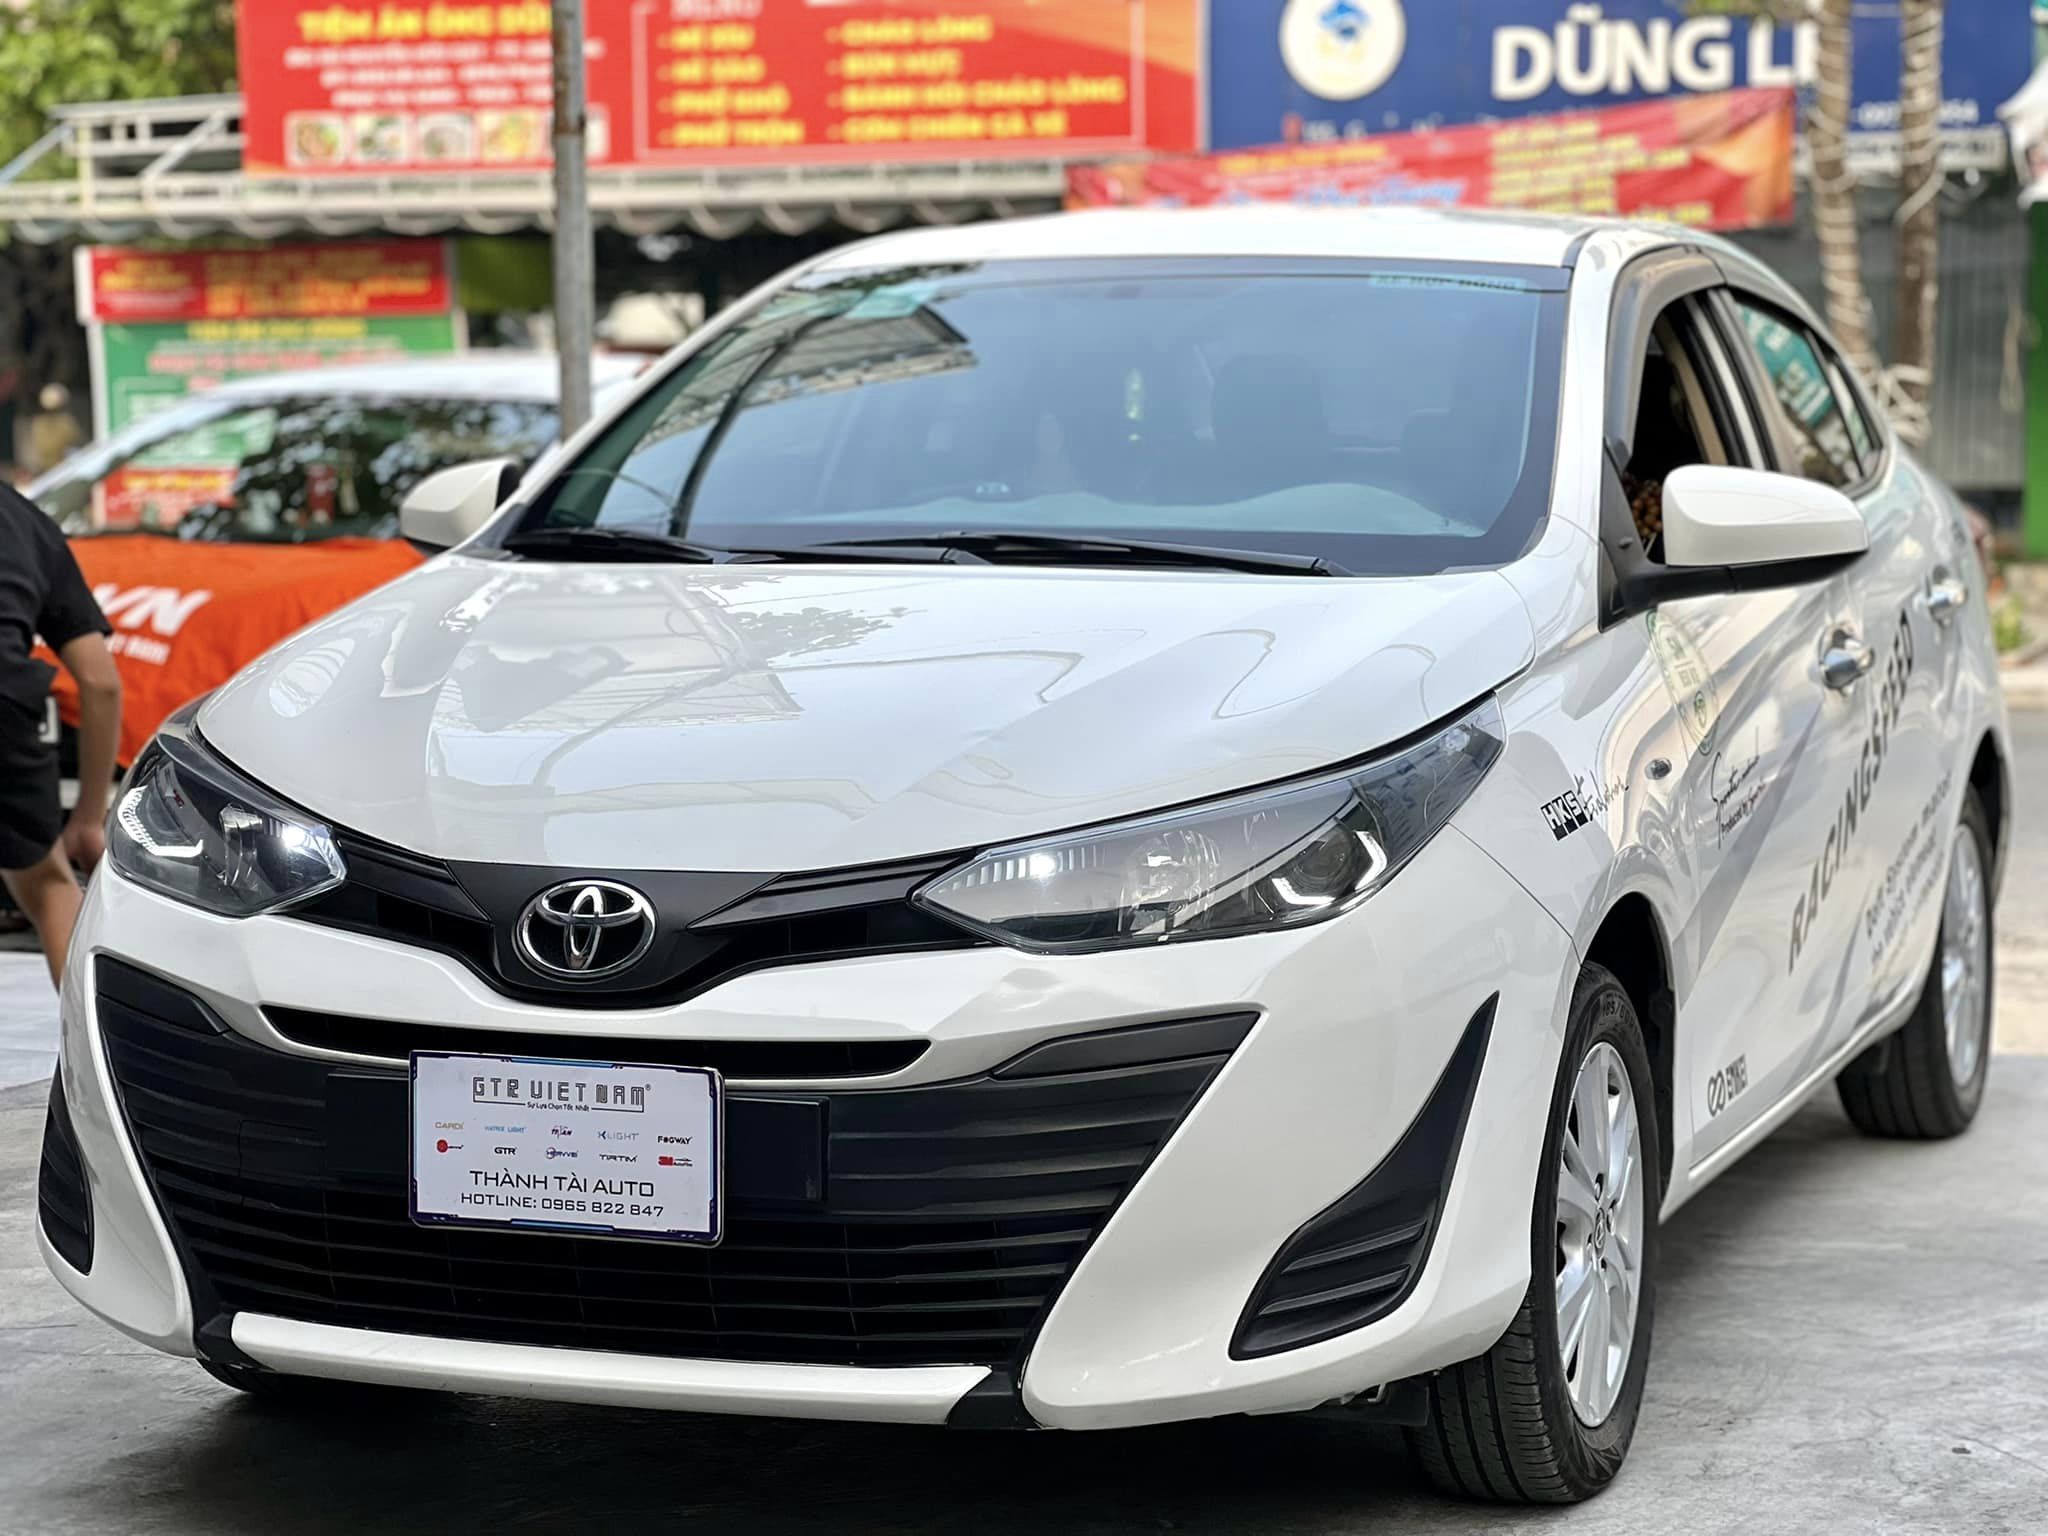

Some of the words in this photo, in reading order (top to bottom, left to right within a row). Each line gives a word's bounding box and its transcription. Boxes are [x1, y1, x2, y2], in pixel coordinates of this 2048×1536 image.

[1491, 3, 1733, 102] DŨNG
[1540, 790, 1588, 841] HKS
[472, 1076, 520, 1099] GTR
[494, 1146, 518, 1156] GTR
[469, 1167, 548, 1191] THÀNH
[553, 1172, 588, 1194] TÀI
[592, 1178, 655, 1198] AUTO
[461, 1192, 537, 1209] HOTLINE:
[541, 1197, 587, 1212] 0965
[591, 1201, 625, 1215] 822
[630, 1204, 664, 1217] 847
